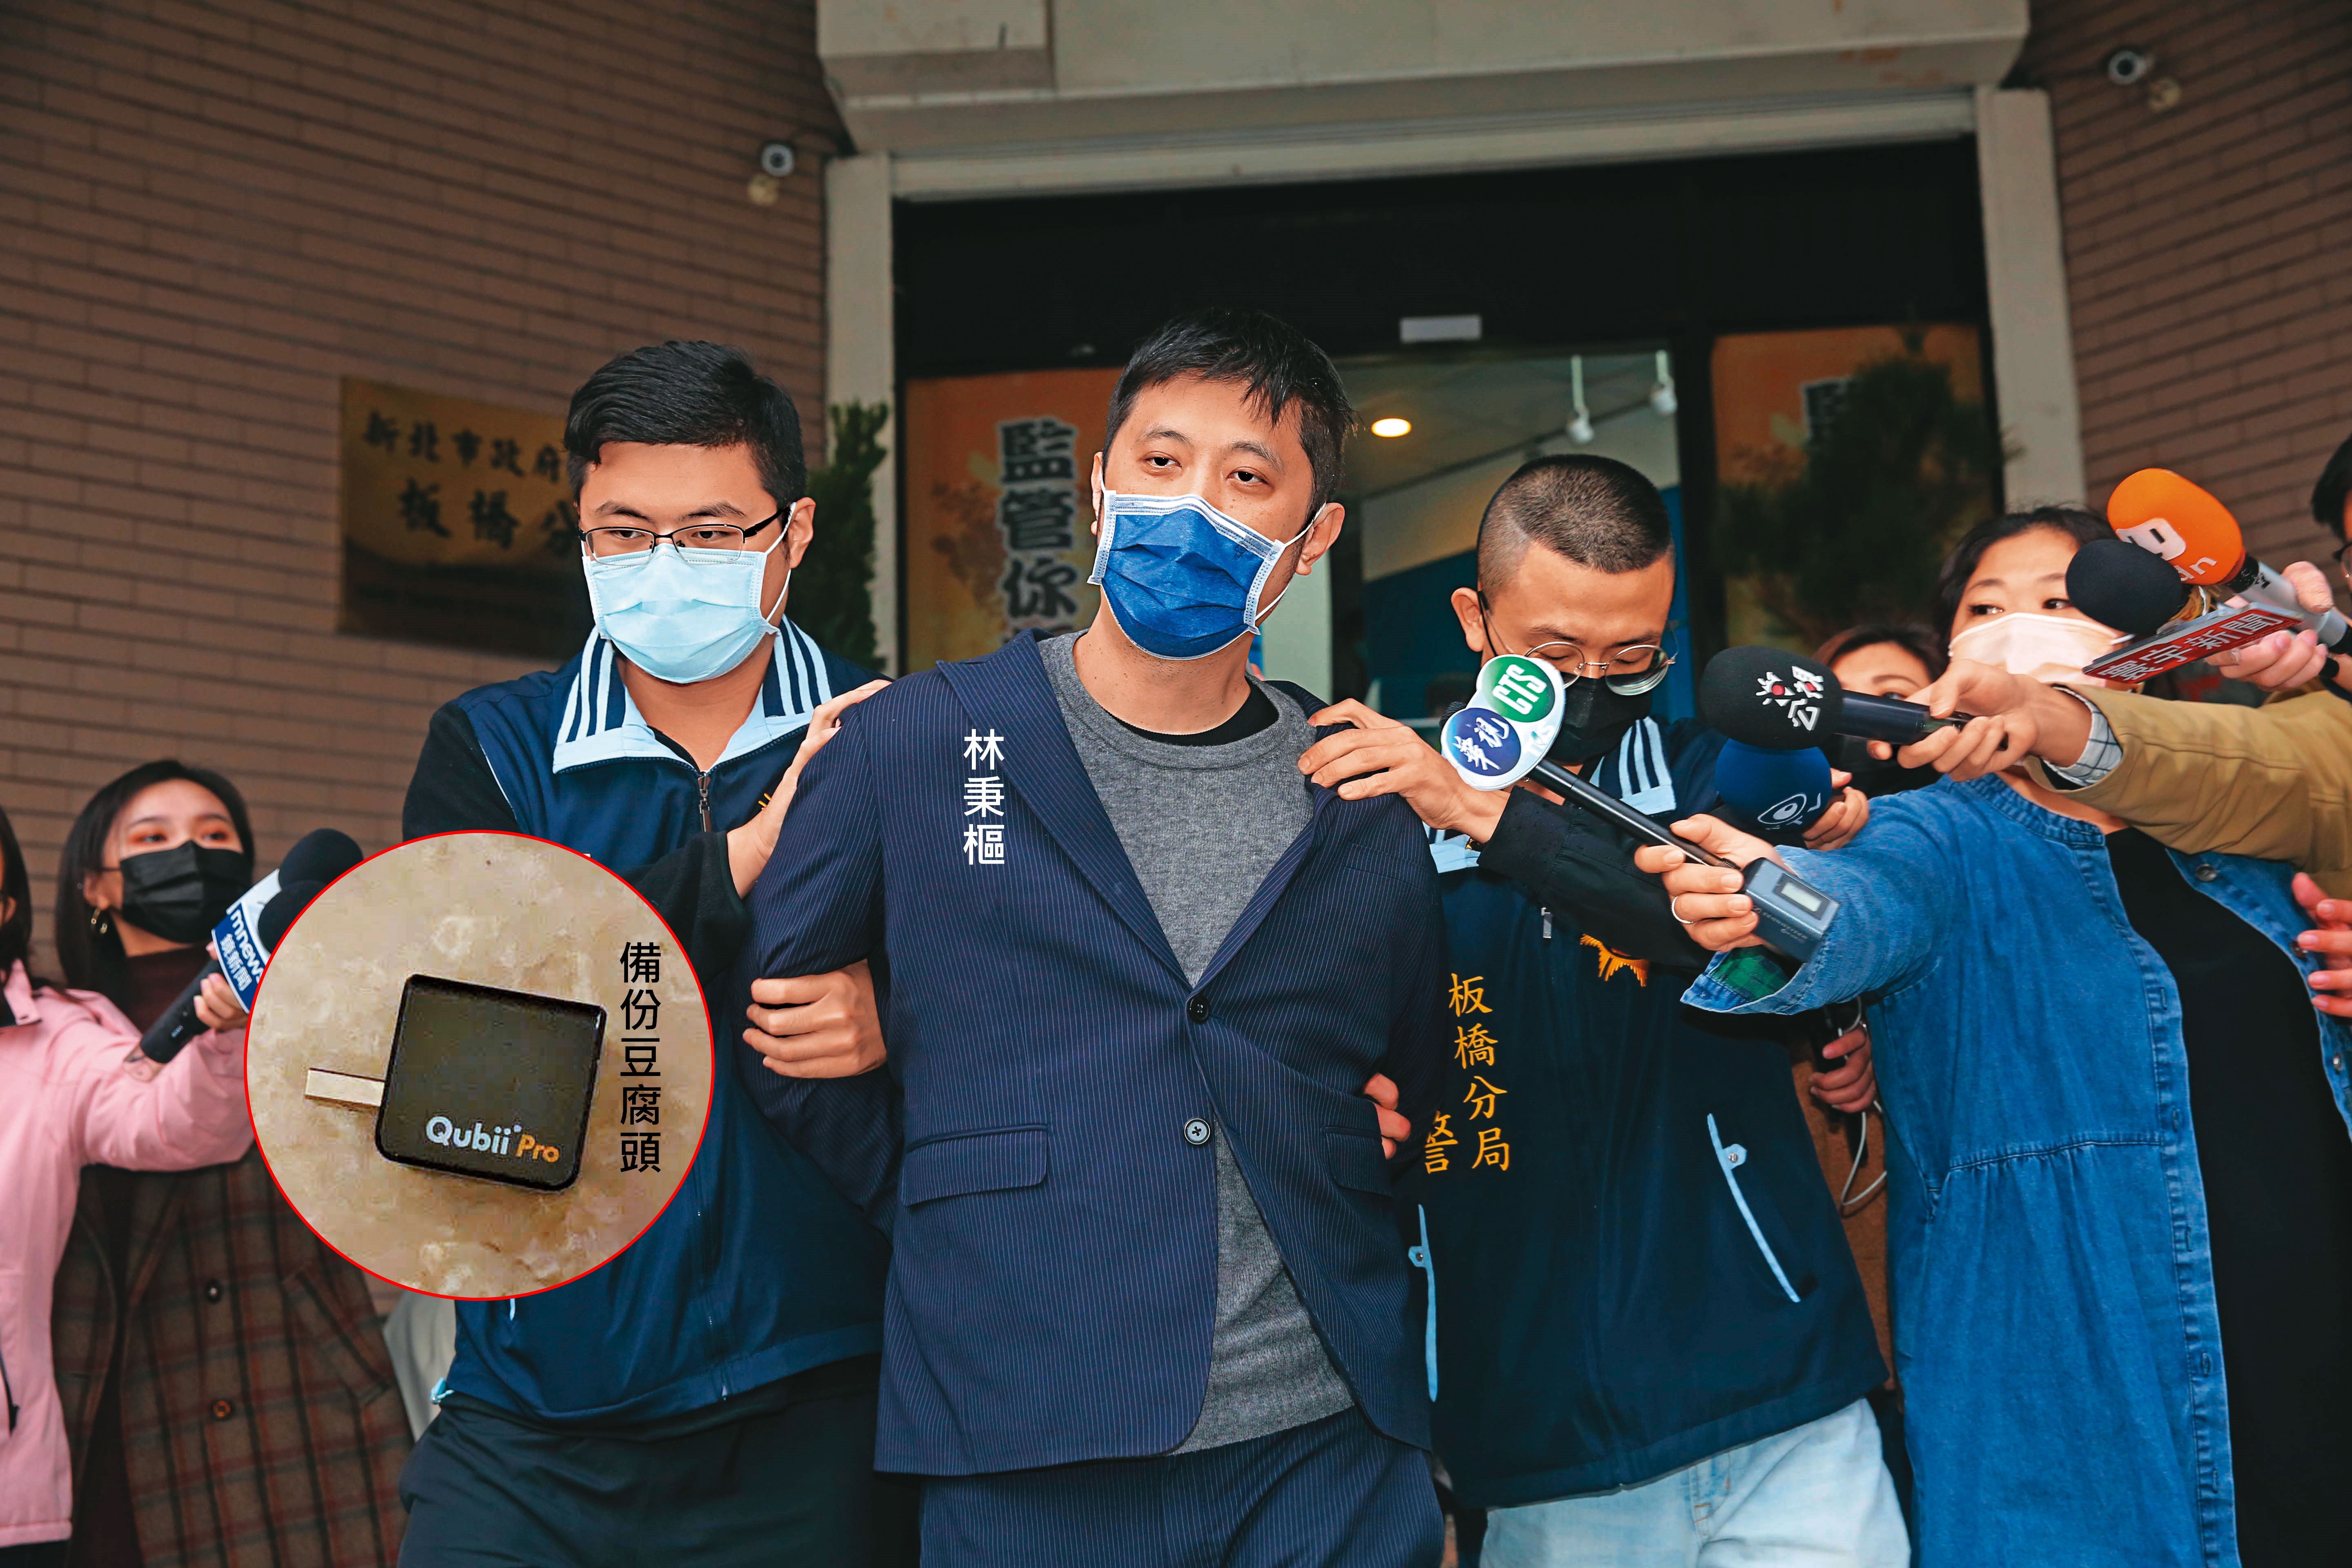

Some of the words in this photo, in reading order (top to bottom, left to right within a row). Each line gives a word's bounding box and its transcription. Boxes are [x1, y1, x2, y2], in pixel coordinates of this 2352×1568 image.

[1000, 416, 1078, 646] 監管你
[2174, 557, 2217, 582] dn
[2099, 613, 2283, 681] 寰宇新聞
[1492, 664, 1547, 715] CTS
[1452, 717, 1510, 771] 華視
[1448, 973, 1510, 1171] 板橋分局
[426, 1116, 512, 1155] Qubii
[515, 1135, 561, 1163] Pro
